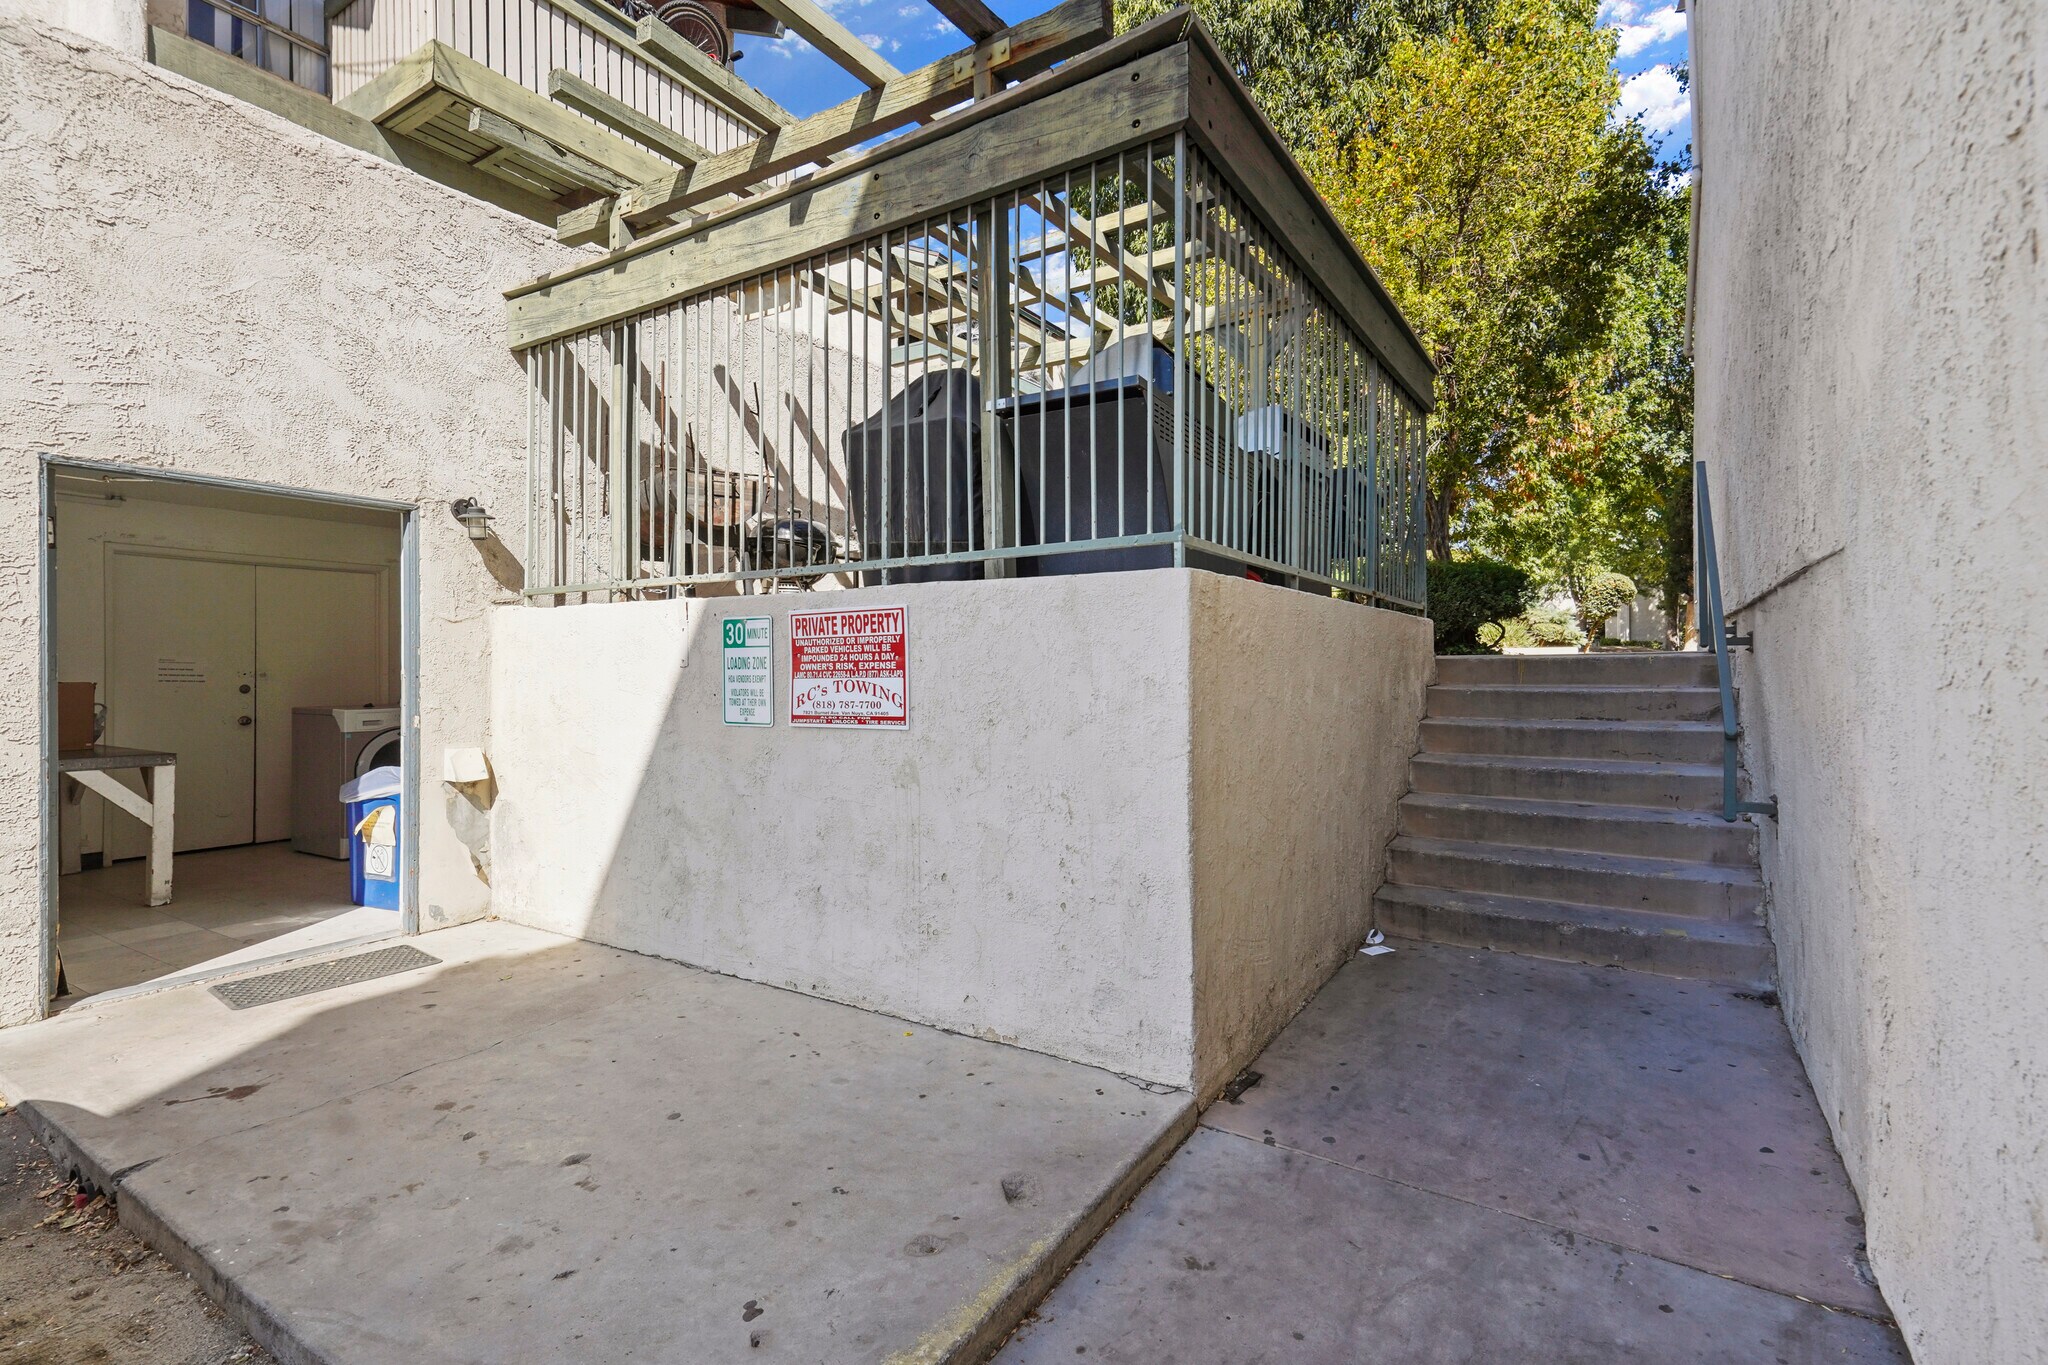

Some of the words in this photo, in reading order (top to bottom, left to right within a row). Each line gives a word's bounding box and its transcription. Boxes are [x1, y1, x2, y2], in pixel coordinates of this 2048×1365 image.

[795, 616, 837, 636] PRIVATE
[841, 612, 899, 634] PROPERTY
[726, 623, 743, 644] 30
[747, 628, 768, 639] MINUTE
[796, 638, 844, 646] UNAUTHORIZED
[857, 636, 900, 644] IMPROPERLY
[727, 657, 750, 670] LOADING
[753, 657, 767, 669] ZONE
[836, 662, 856, 670] RISK,
[833, 679, 903, 709] TOWING
[813, 701, 835, 710] (818)
[839, 701, 881, 709] 787-7700
